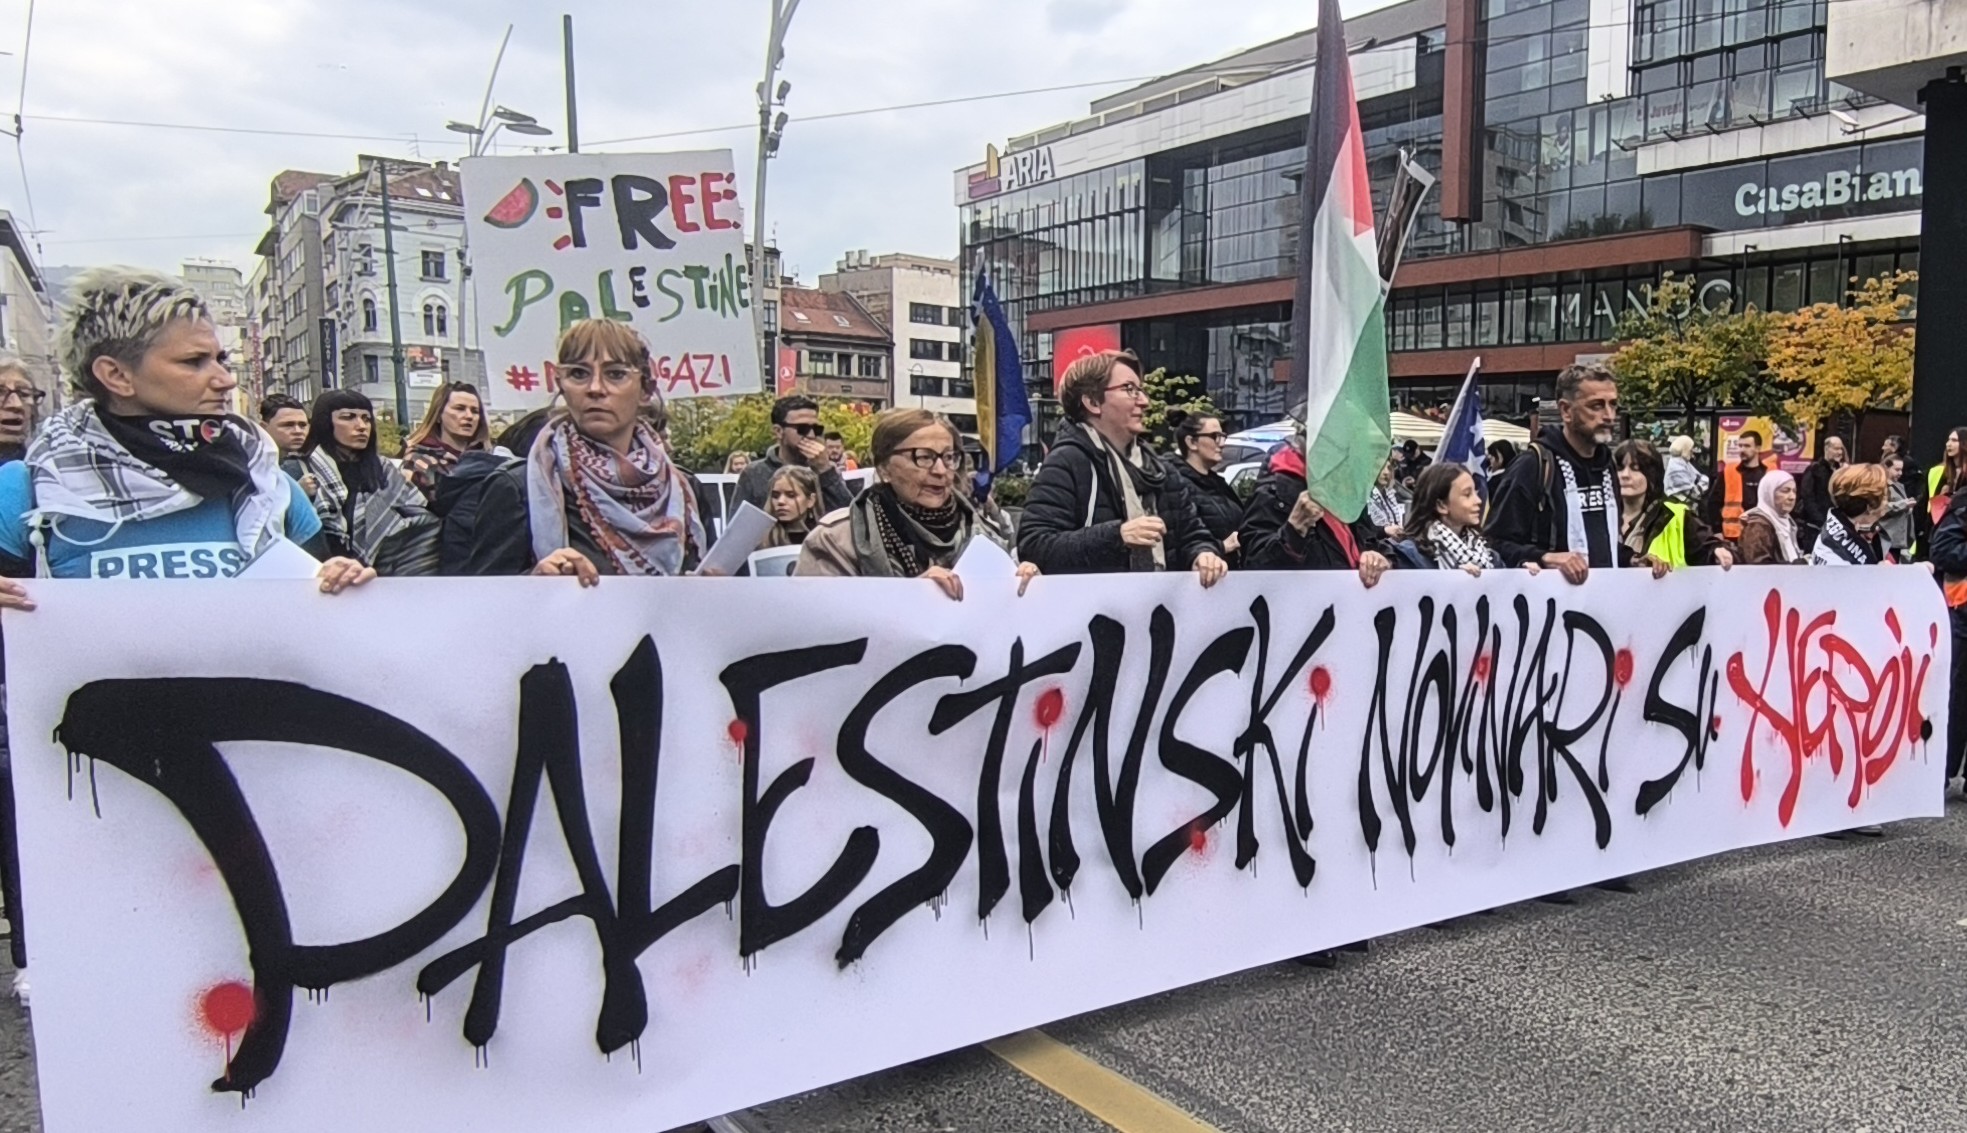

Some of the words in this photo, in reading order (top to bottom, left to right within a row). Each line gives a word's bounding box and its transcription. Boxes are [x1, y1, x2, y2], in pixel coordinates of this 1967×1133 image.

[1001, 146, 1055, 190] ARIA
[565, 173, 732, 250] FREE
[98, 548, 241, 579] PRESS
